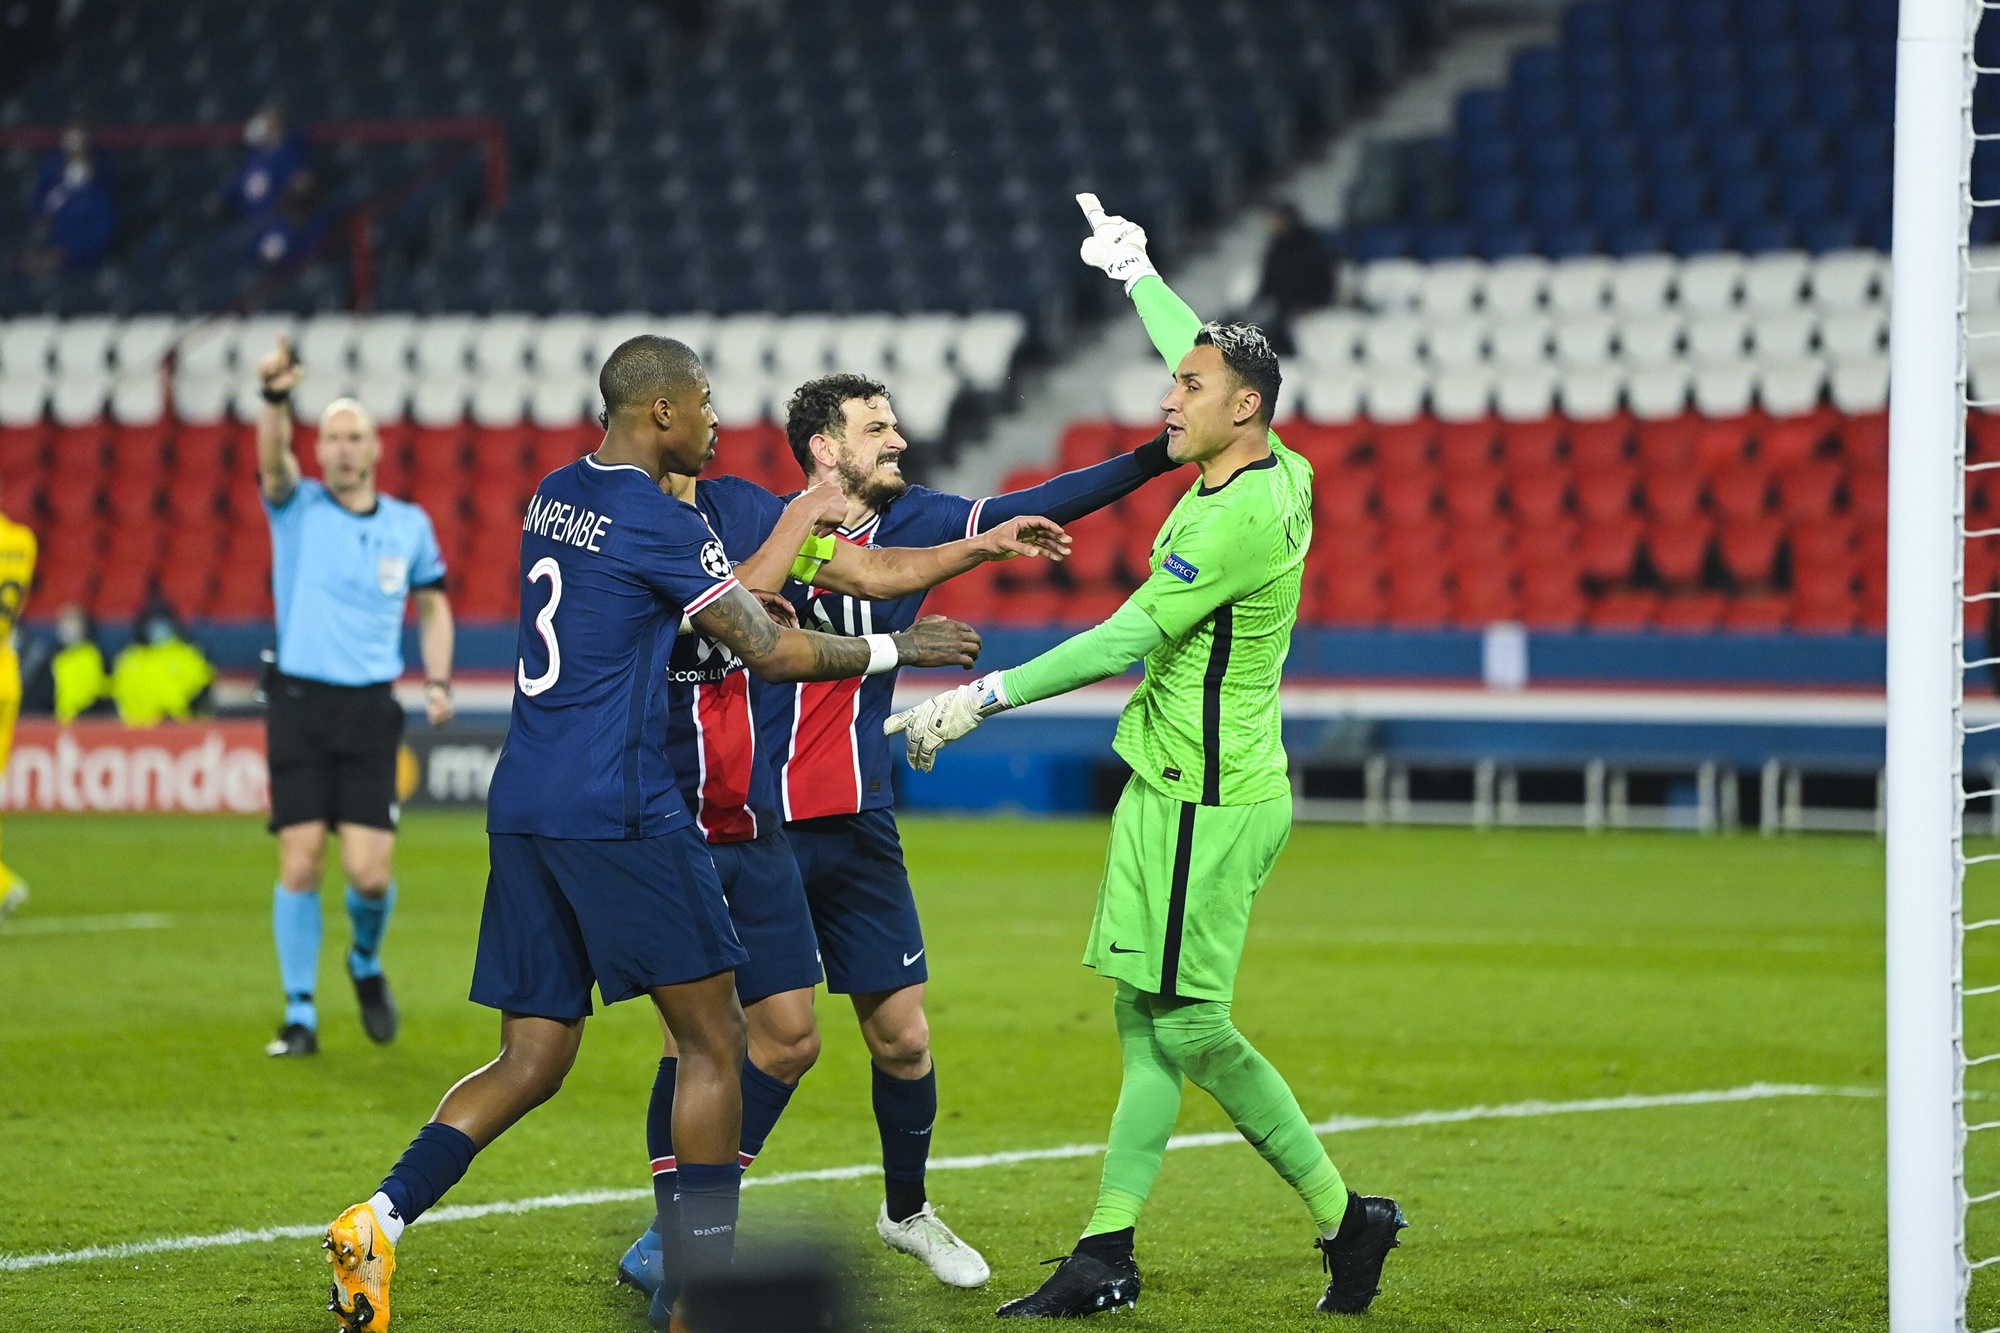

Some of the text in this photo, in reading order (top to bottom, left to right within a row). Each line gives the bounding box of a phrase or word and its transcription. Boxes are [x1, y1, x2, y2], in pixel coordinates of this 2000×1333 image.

[1168, 557, 1197, 579] RESPECT
[518, 557, 562, 697] 3
[667, 670, 706, 682] CCOR
[0, 731, 269, 812] ntande
[693, 1225, 732, 1236] PARIS
